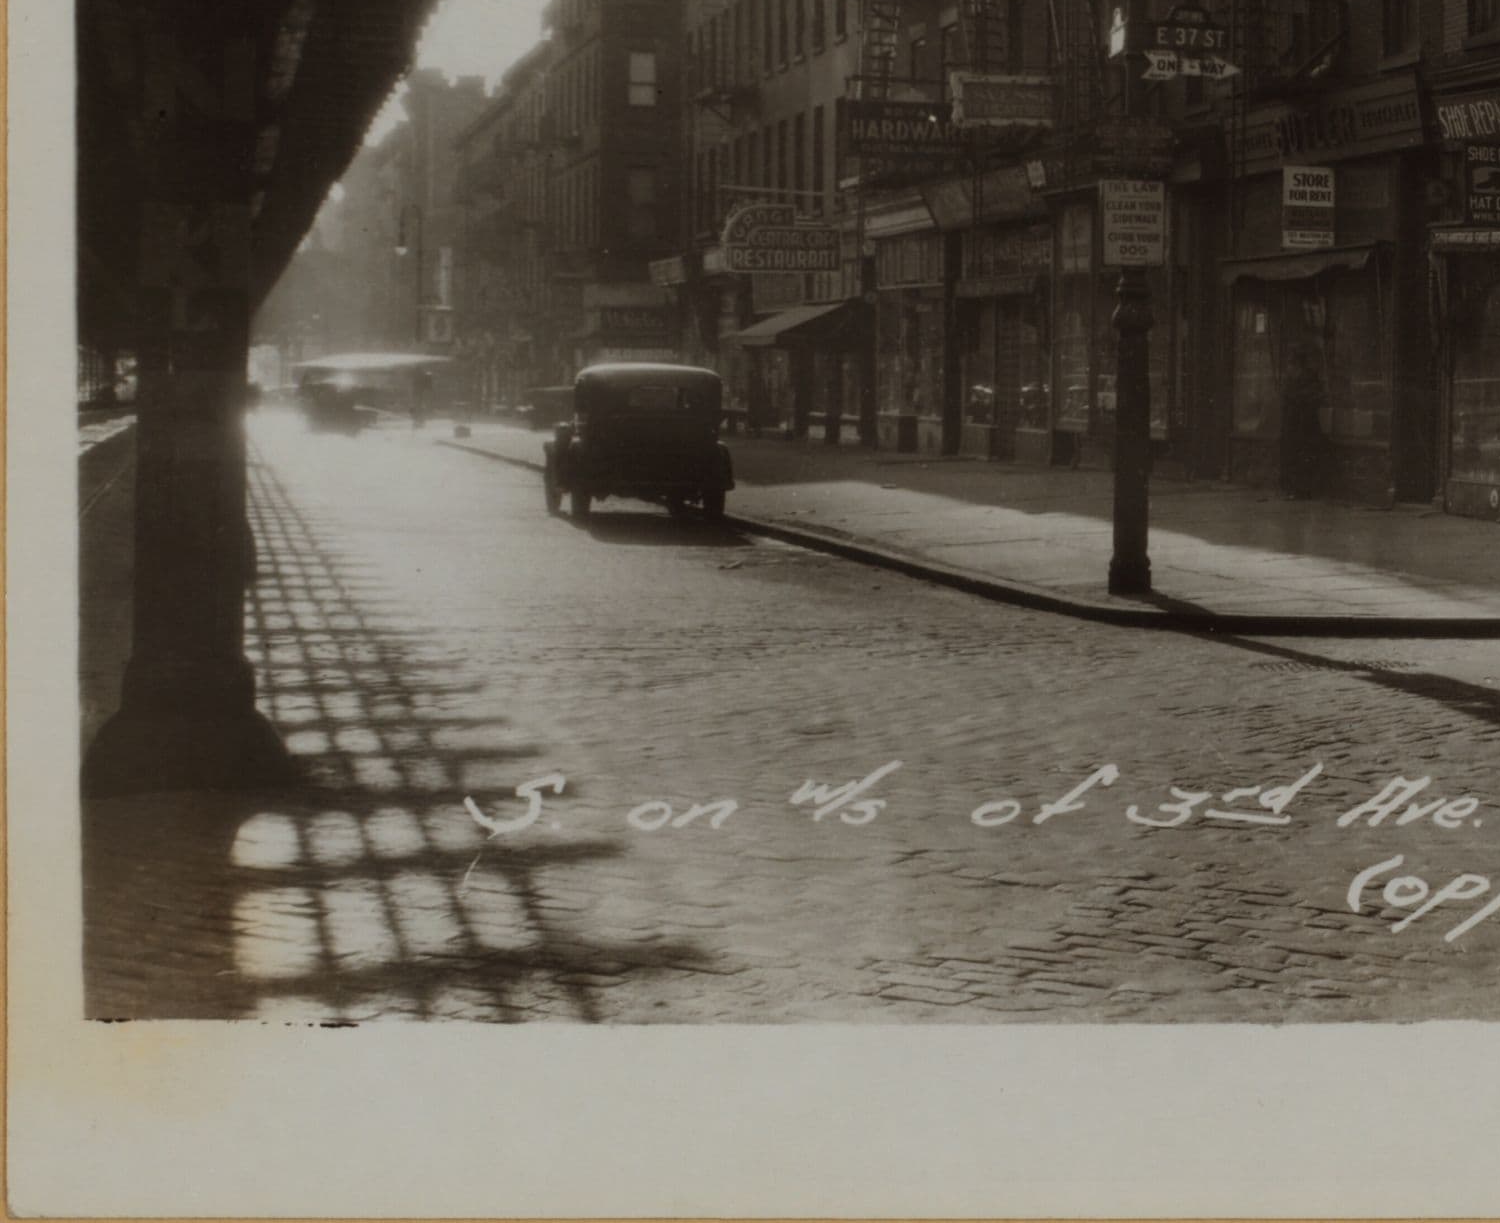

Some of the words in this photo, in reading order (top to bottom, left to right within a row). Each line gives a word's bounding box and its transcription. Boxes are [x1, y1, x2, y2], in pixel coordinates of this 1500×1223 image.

[1157, 26, 1168, 45] E
[1175, 27, 1198, 47] 37
[1203, 29, 1225, 49] ST
[1438, 103, 1472, 139] SHOE
[1467, 145, 1497, 162] SHOE
[1108, 183, 1129, 193] THE
[1132, 183, 1160, 193] LAW
[1293, 173, 1330, 188] STORE
[1289, 190, 1308, 201] FOR
[1310, 190, 1332, 202] RENT
[1469, 195, 1493, 210] HAT
[733, 249, 839, 269] RESTAURANT
